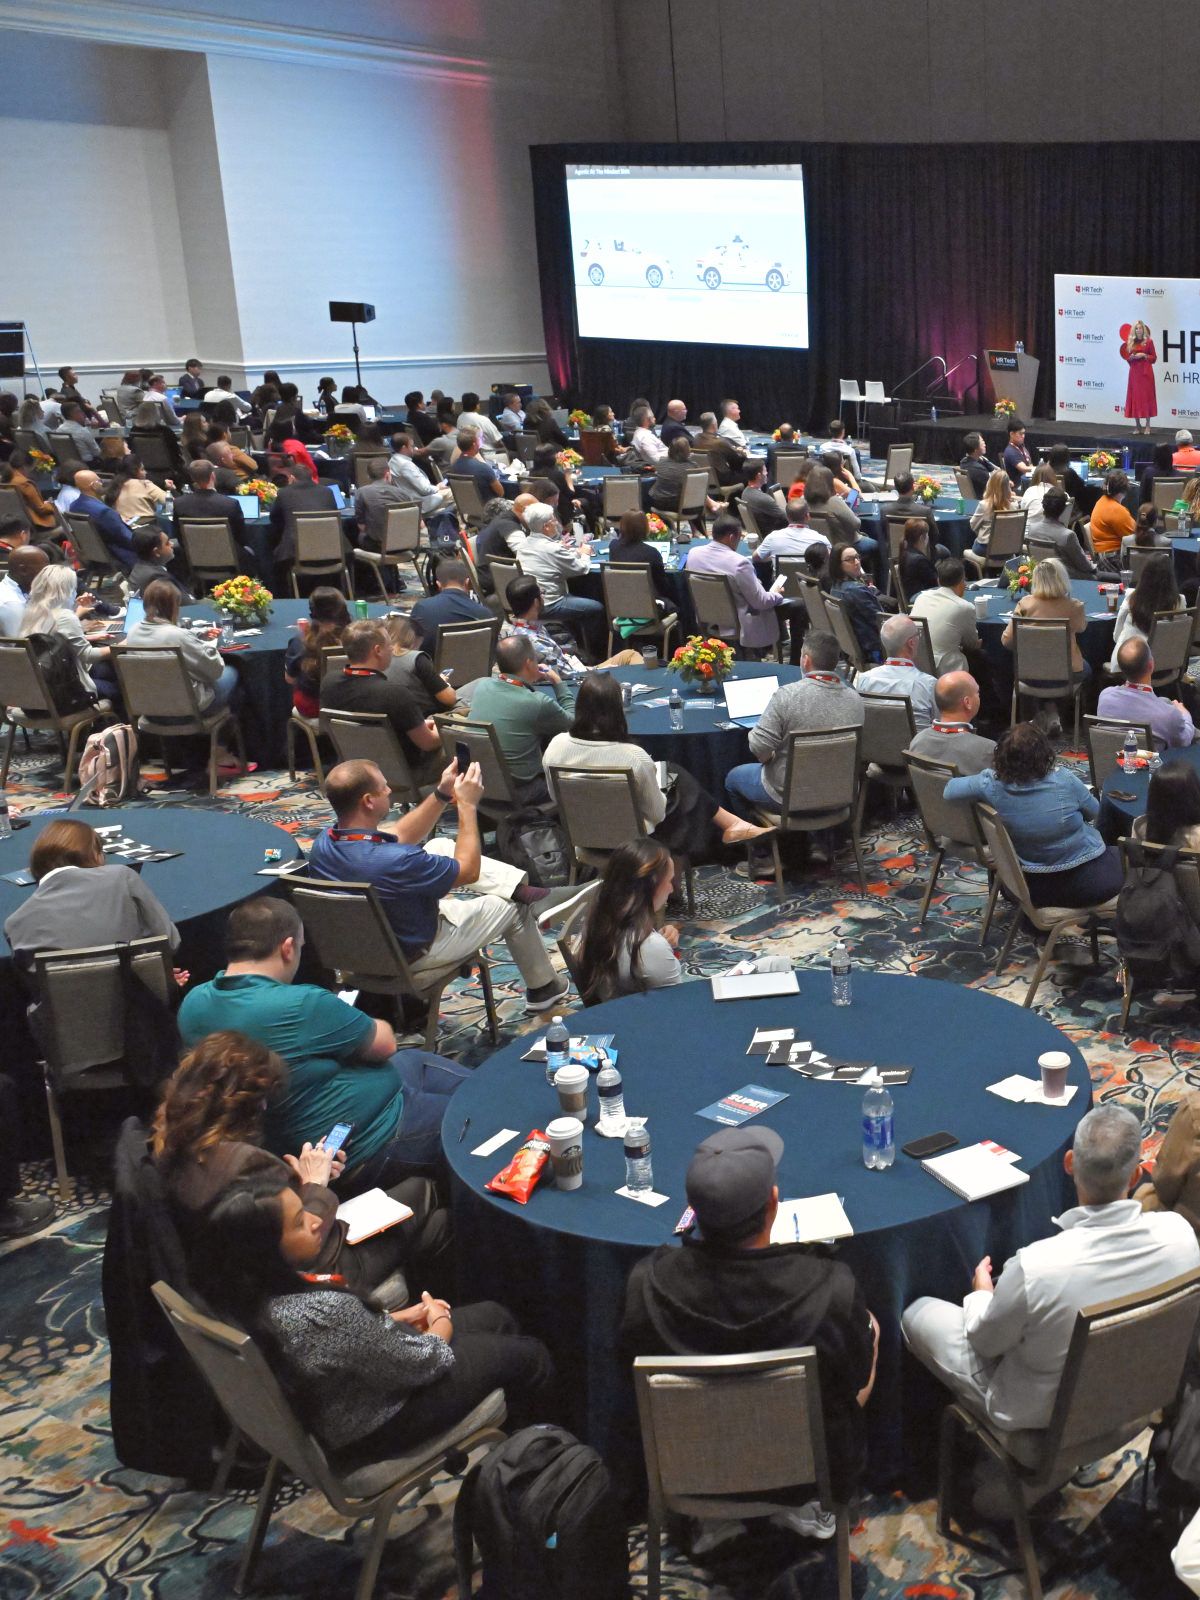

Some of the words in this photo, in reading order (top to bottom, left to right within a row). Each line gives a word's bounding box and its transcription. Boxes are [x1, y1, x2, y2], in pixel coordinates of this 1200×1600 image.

[1163, 371, 1179, 384] An
[1182, 372, 1200, 385] HR
[727, 1093, 768, 1109] SUPER
